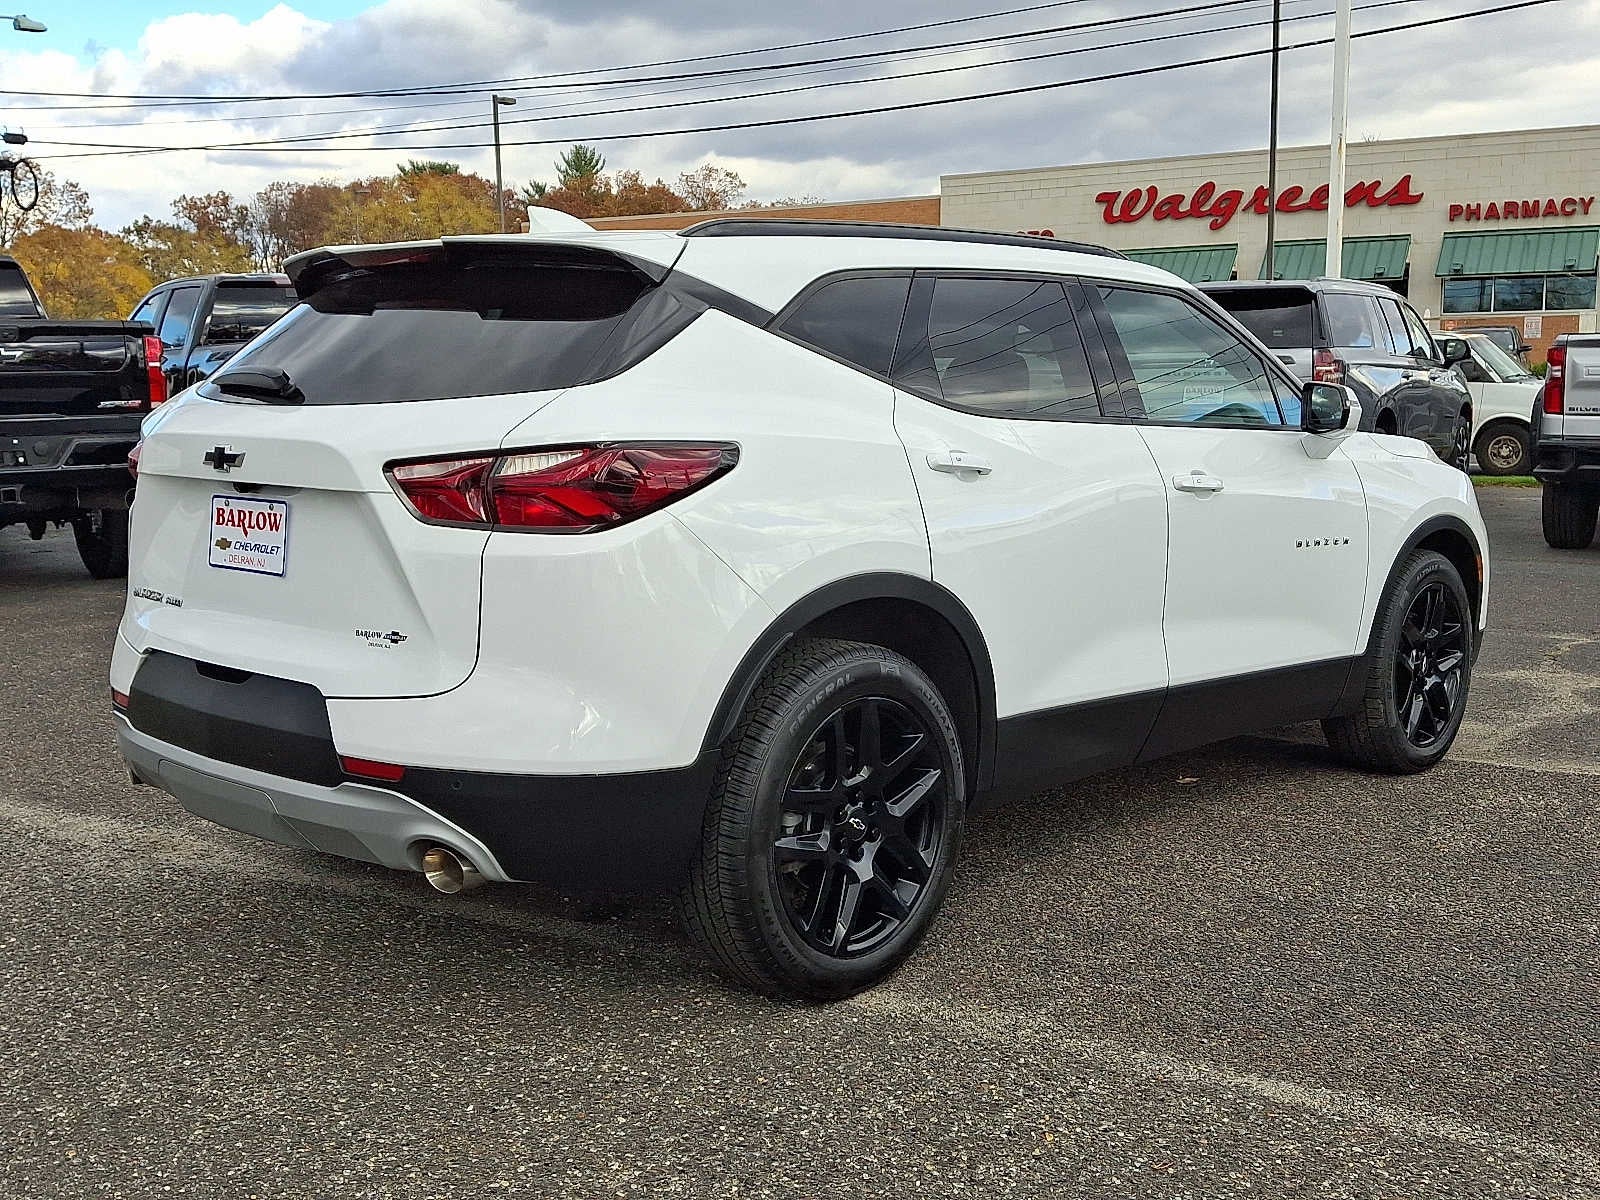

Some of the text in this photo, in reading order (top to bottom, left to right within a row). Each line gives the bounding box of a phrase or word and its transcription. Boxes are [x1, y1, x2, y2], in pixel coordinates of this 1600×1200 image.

[1096, 176, 1424, 231] Walgreens
[1448, 196, 1595, 222] PHARMACY
[215, 507, 282, 538] BARLOW
[233, 541, 281, 555] CHEVROLET
[1295, 536, 1350, 549] BLAZER
[355, 630, 382, 640] BARLOW
[789, 672, 852, 737] GENERAL
